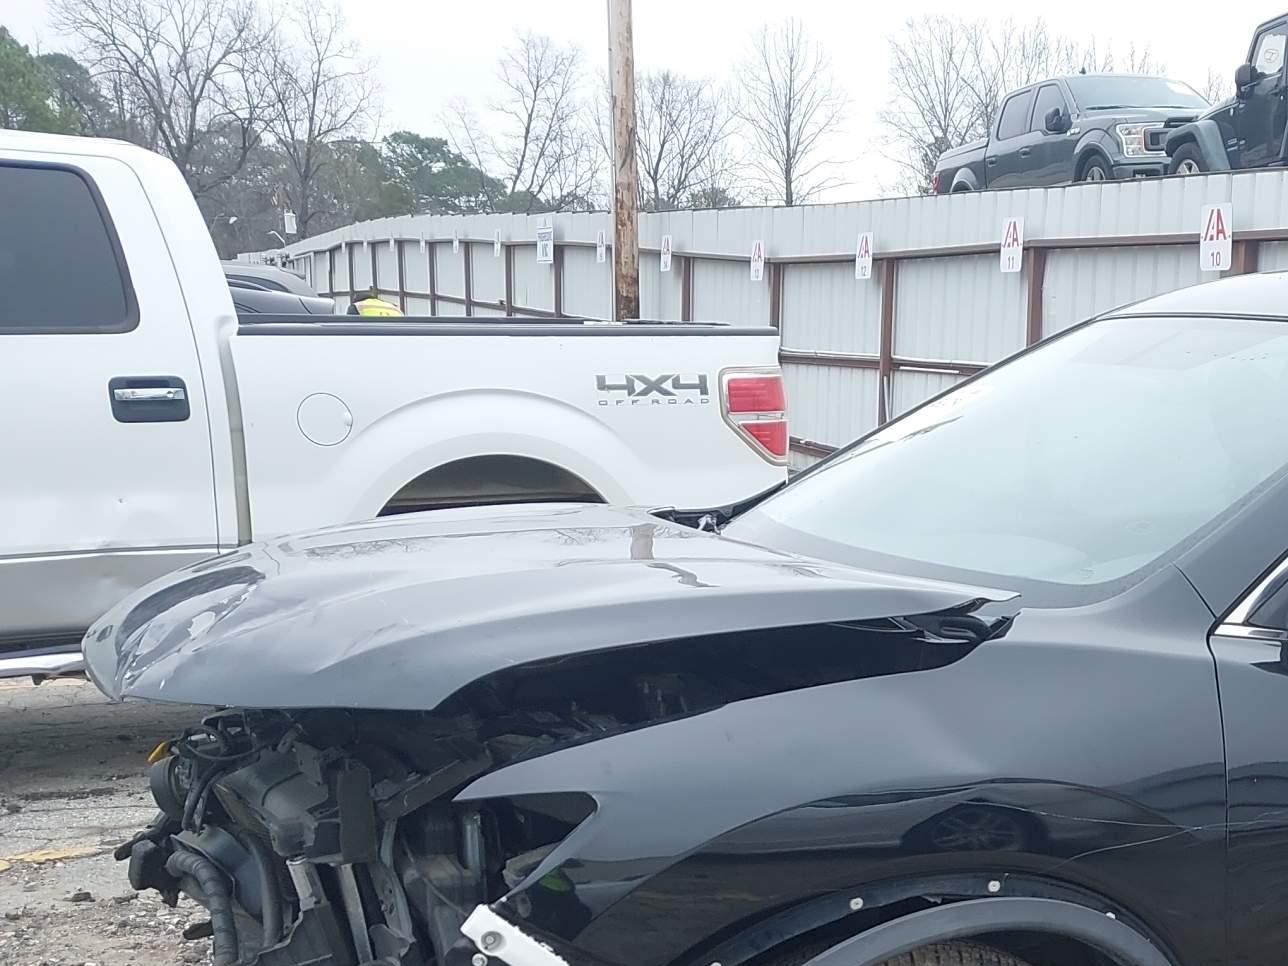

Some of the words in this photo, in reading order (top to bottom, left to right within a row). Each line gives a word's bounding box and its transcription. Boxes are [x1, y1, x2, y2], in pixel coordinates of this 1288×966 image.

[1008, 255, 1014, 270] 11
[1211, 251, 1221, 267] 10
[596, 374, 709, 397] 4X4
